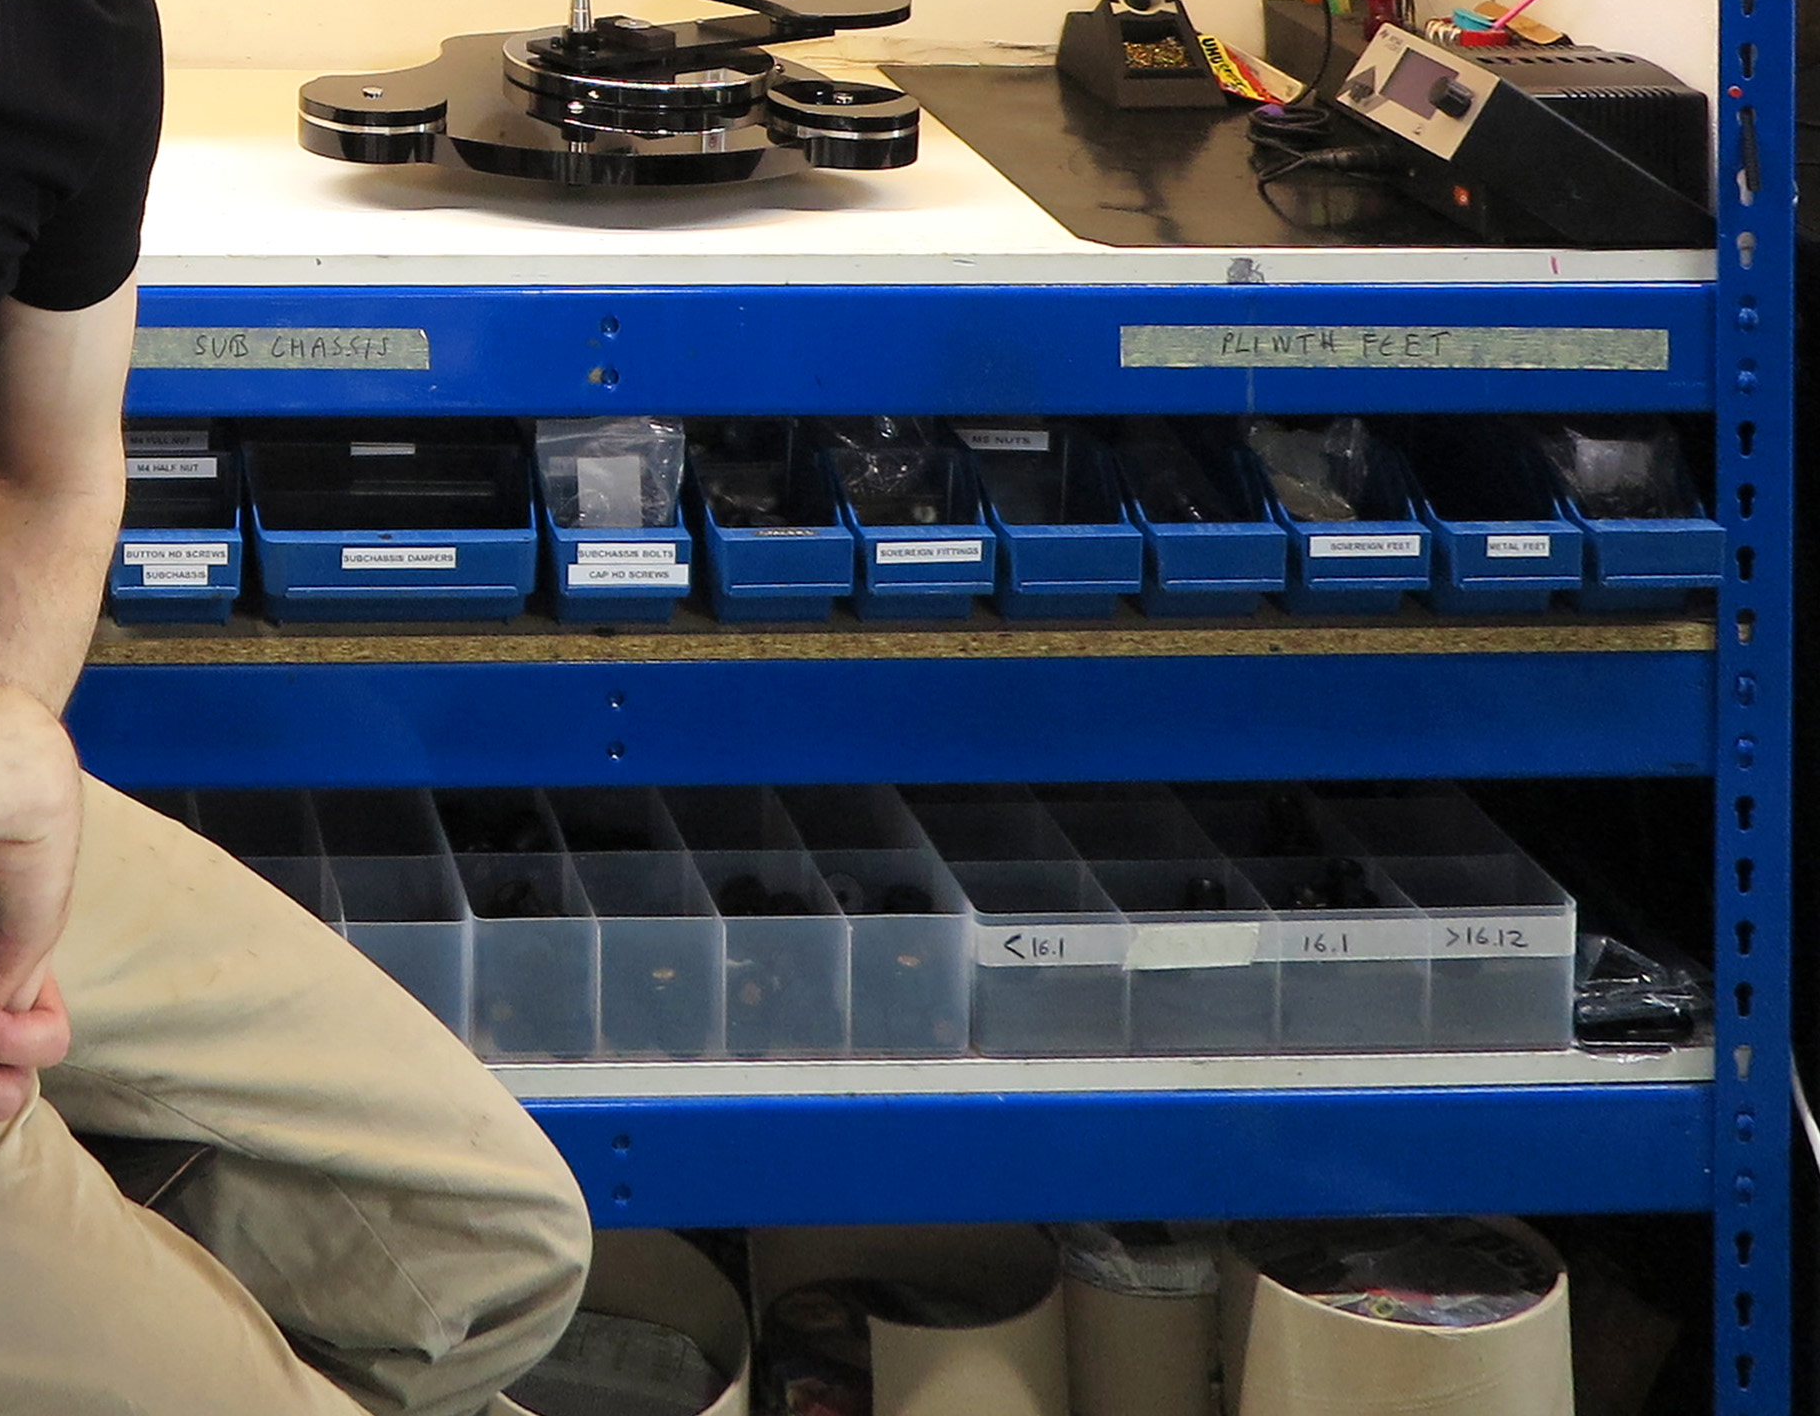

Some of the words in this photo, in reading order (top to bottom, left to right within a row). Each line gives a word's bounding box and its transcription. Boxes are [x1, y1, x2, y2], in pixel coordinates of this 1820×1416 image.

[1201, 37, 1225, 65] UHU
[195, 334, 250, 359] SUB
[271, 335, 389, 360] CHASSIS
[1222, 330, 1338, 356] PLINTH
[1362, 331, 1453, 358] FEET
[995, 435, 1031, 445] NUTS
[180, 464, 199, 472] NUT
[1330, 541, 1384, 551] SOVEREIGN
[1386, 541, 1411, 551] FEET
[1488, 541, 1520, 552] METAL
[1522, 541, 1547, 551] FEET
[126, 550, 165, 559] BUTTON
[168, 550, 182, 559] HD
[185, 550, 226, 559] SCREWS
[577, 549, 639, 559] SUBCHASSIS
[642, 549, 674, 559] BOLTS
[880, 547, 935, 558] SOVEREIGN
[936, 546, 979, 557] FITTINGS
[343, 554, 405, 563] SUBCHASSIS
[407, 553, 454, 563] DAMPERS
[145, 571, 206, 580] SUBCHASSIS
[588, 570, 608, 579] CAP
[611, 570, 625, 579] HD
[628, 570, 670, 579] SCREWS
[1302, 934, 1349, 954] 16.1
